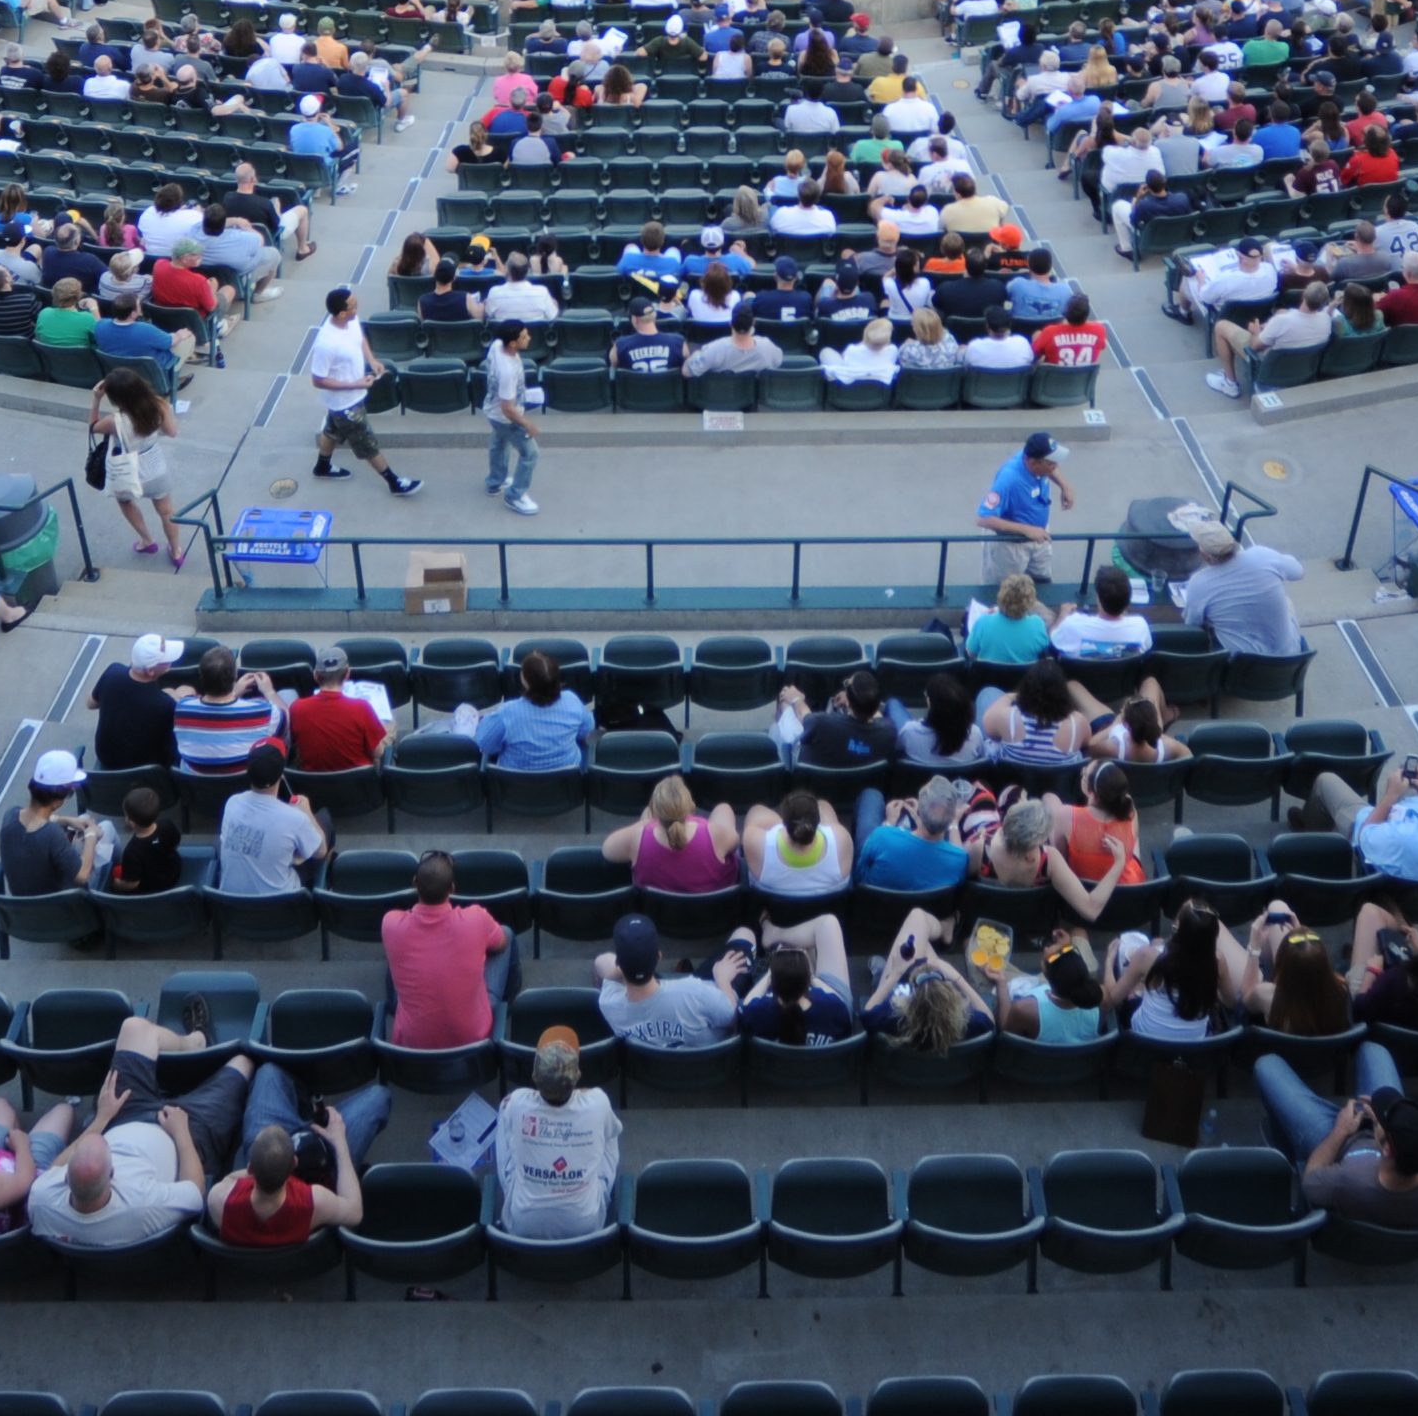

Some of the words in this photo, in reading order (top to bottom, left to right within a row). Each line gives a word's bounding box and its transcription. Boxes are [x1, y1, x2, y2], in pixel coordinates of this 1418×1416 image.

[1054, 334, 1098, 347] HALLADAY
[629, 346, 670, 362] TEIXEIRA
[1058, 347, 1093, 366] 34
[1086, 412, 1102, 422] 12
[554, 1128, 593, 1142] Difference
[523, 1164, 583, 1180] VERSA-LOK
